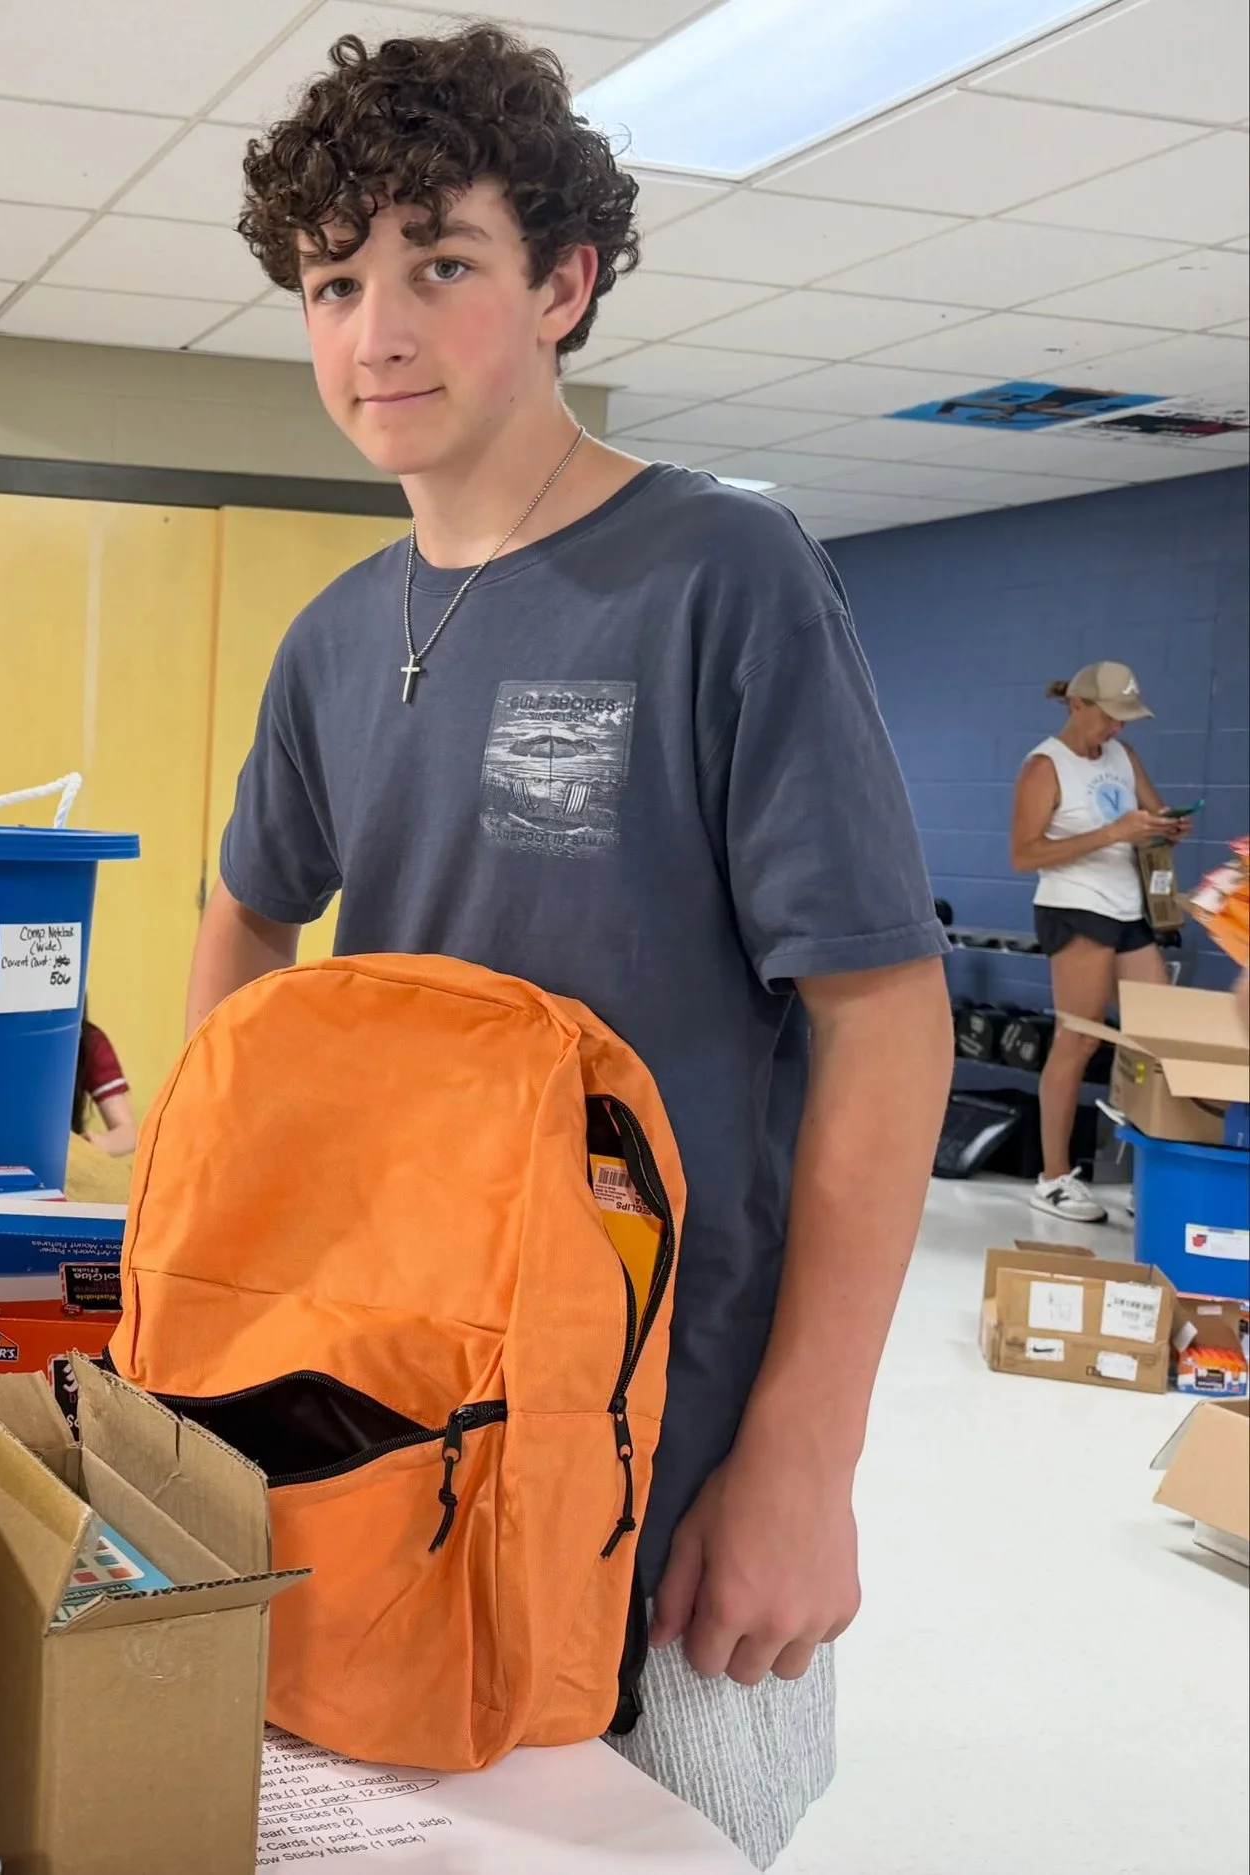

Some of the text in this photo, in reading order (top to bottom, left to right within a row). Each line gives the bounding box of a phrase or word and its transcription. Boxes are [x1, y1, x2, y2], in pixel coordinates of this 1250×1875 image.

[510, 696, 617, 711] GULF SHORES
[529, 711, 560, 721] SINCE
[19, 926, 46, 942] Comp
[70, 1241, 98, 1250] Mount
[72, 1248, 111, 1257] Artwork
[73, 1272, 104, 1282] Glue
[282, 1750, 329, 1761] Pencils
[261, 1766, 282, 1777] ard
[284, 1760, 329, 1773] Marker
[260, 1792, 282, 1801] ers
[283, 1787, 298, 1799] (1
[338, 1780, 356, 1789] 10
[358, 1773, 399, 1786] count)
[304, 1798, 318, 1808] (1
[359, 1788, 377, 1798] 12
[378, 1782, 420, 1794] count)
[258, 1805, 354, 1826] Glue Sticks (4)
[259, 1816, 364, 1839] earl Erasers (2)
[266, 1839, 309, 1851] Cards
[310, 1835, 325, 1846] (1
[366, 1823, 405, 1836] Lined
[406, 1821, 416, 1830] 1
[418, 1815, 453, 1828] side)
[255, 1833, 427, 1867] low Sticky Notes (1 pack)
